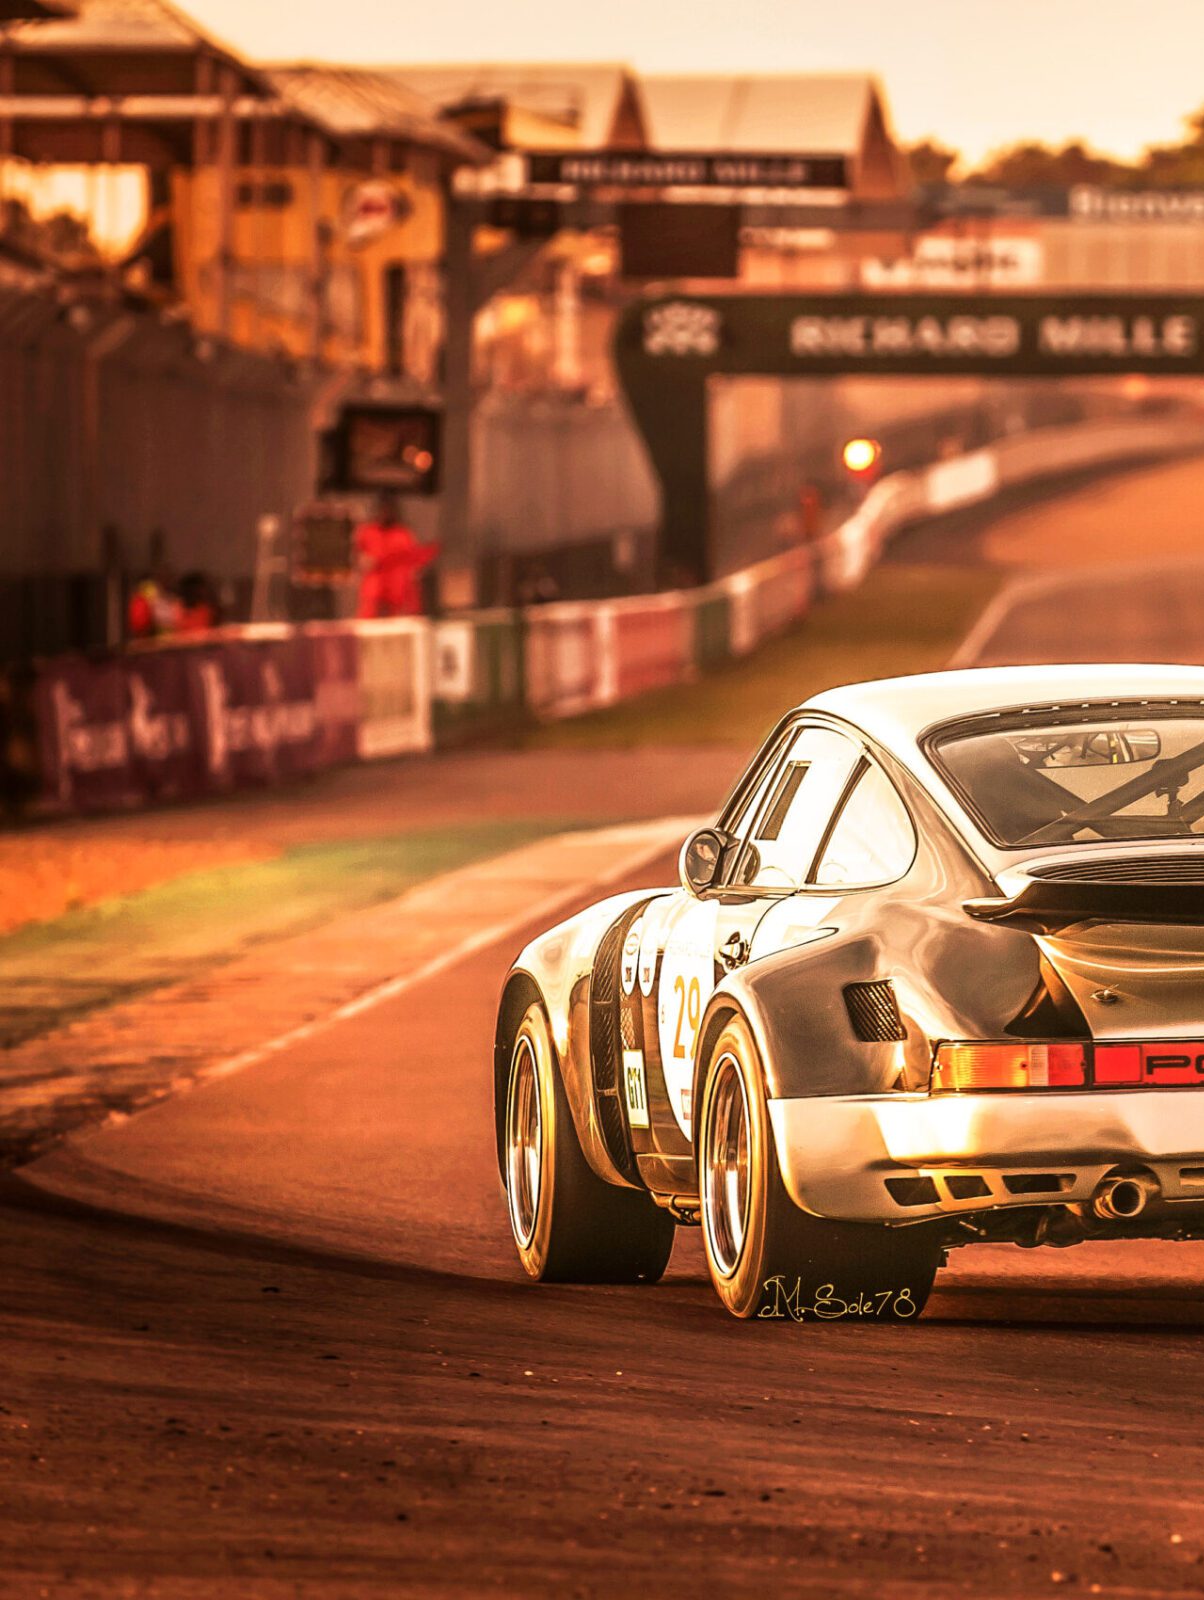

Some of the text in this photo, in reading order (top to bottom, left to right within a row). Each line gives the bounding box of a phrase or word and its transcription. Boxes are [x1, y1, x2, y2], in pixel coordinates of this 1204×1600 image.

[788, 313, 1198, 358] RICHARD MILLE
[673, 975, 701, 1060] 29
